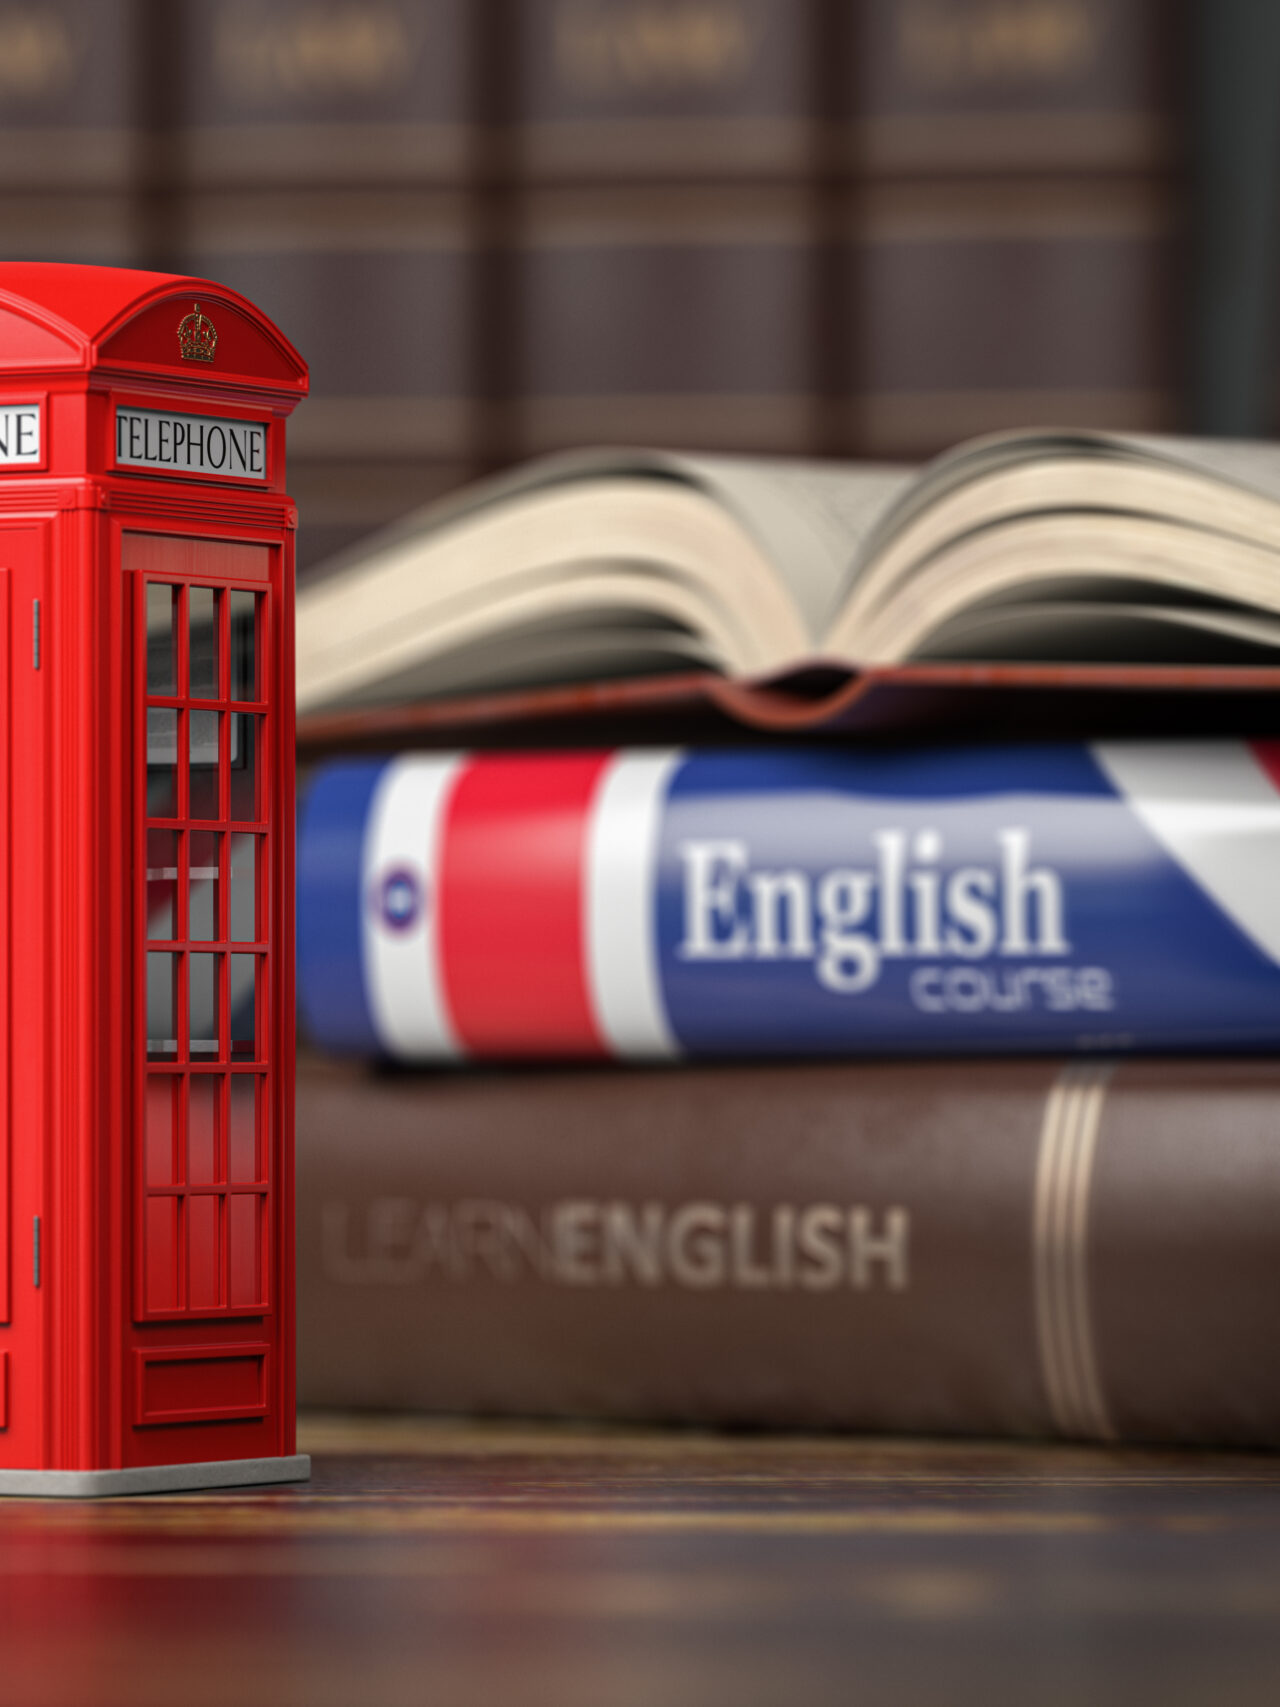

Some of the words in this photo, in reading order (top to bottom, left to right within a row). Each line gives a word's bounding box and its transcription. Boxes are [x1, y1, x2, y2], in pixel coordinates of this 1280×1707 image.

[117, 415, 263, 472] TELEPHONE
[677, 827, 1069, 994] English
[910, 966, 1115, 1013] course
